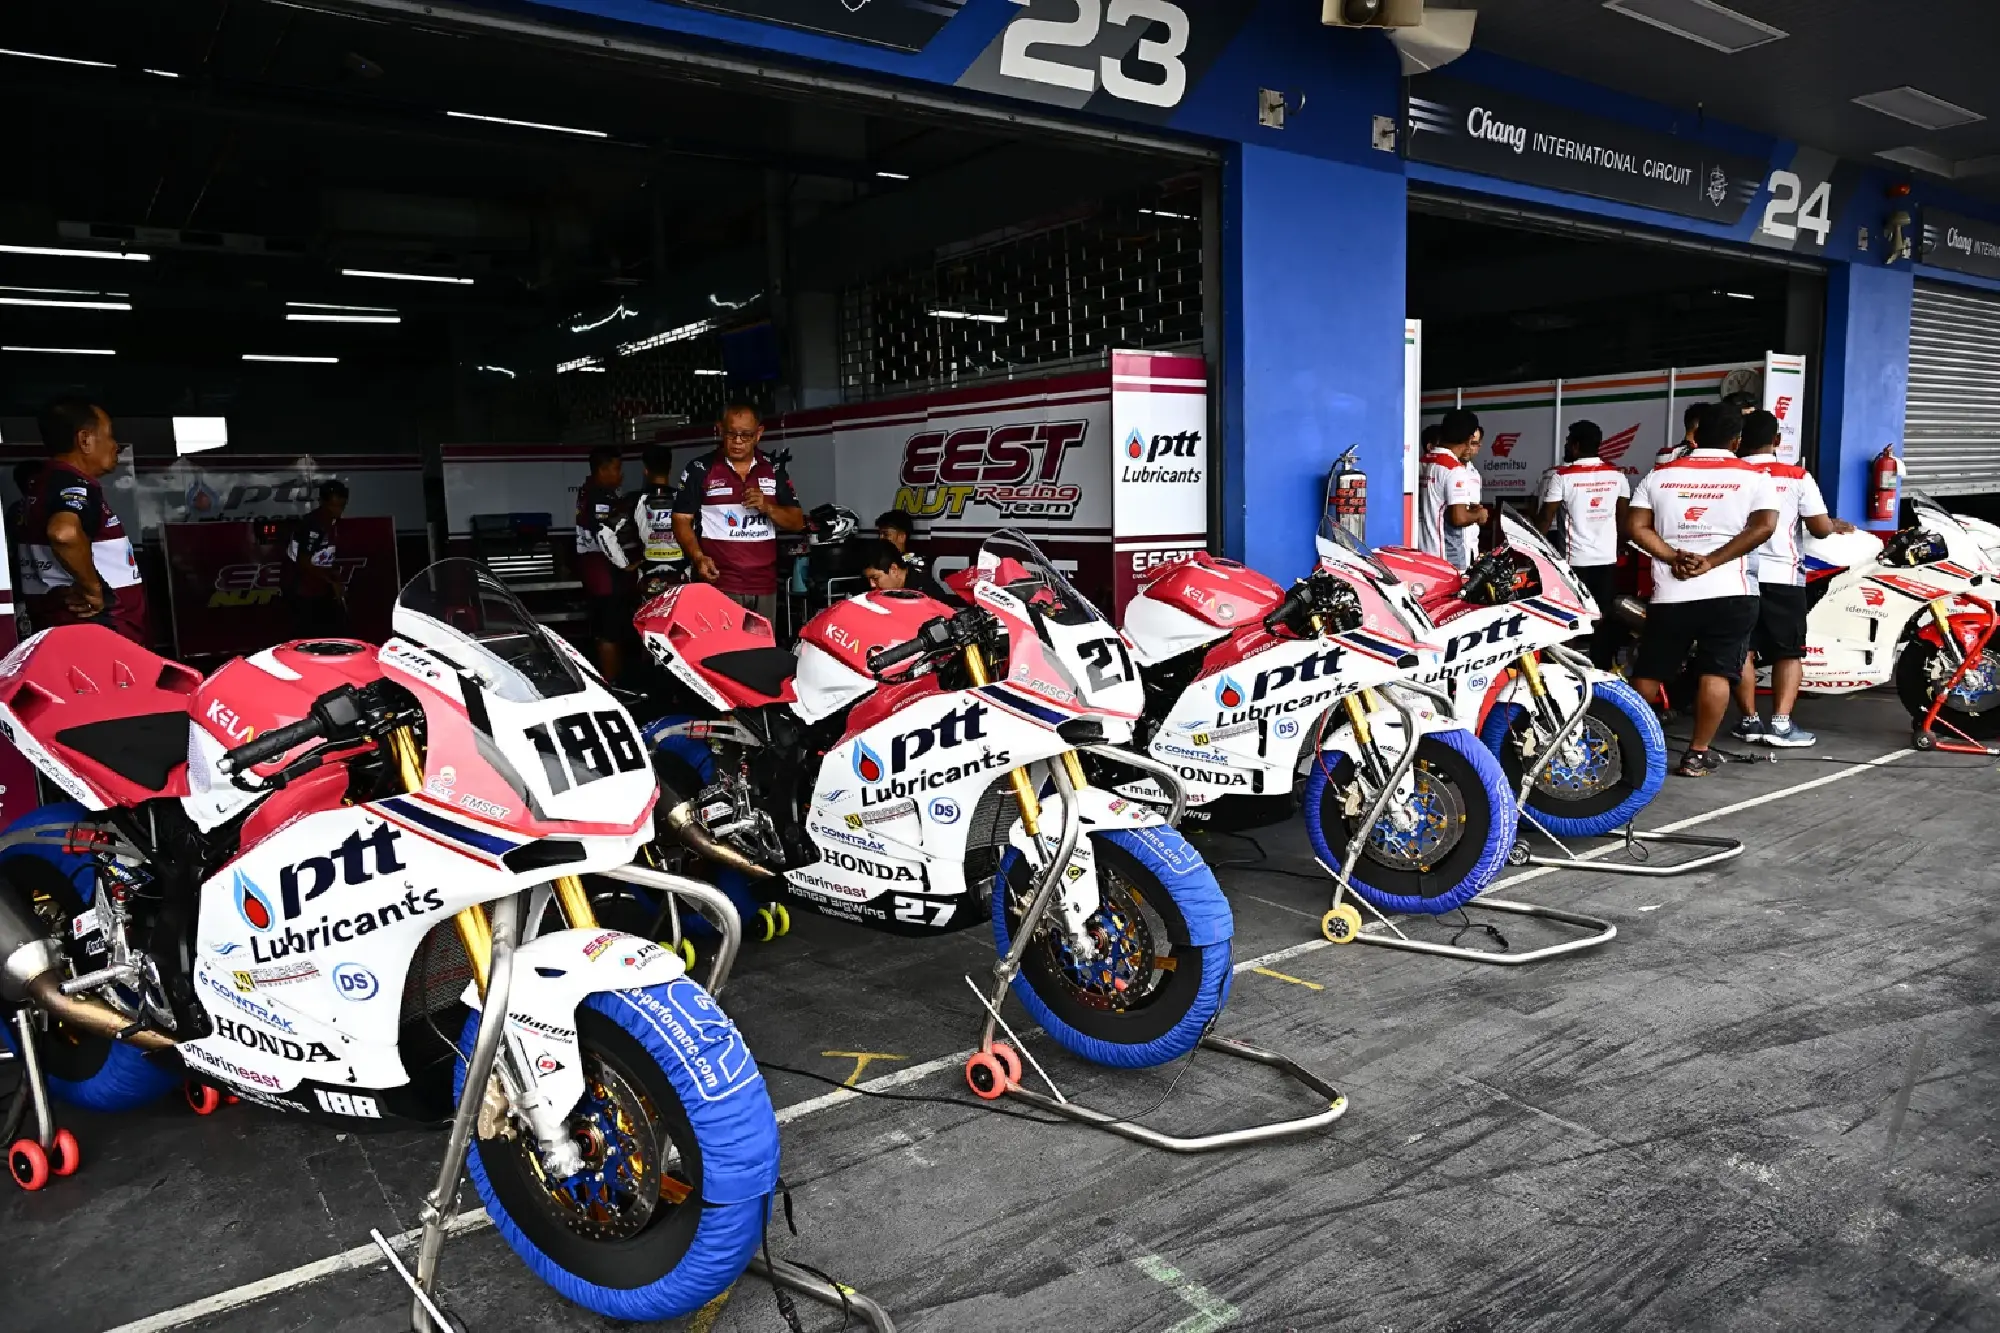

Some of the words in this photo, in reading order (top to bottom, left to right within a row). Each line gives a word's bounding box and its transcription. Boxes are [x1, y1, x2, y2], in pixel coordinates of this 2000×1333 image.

[1000, 0, 1190, 108] 23
[1466, 106, 1527, 154] Chang
[1532, 132, 1638, 174] INTERNATIONAL
[1642, 158, 1693, 186] CIRCUIT
[1762, 169, 1832, 246] 24
[1947, 227, 1973, 255] Chang
[900, 418, 1089, 487] EEST
[1147, 429, 1202, 463] ptt
[1121, 465, 1202, 484] Lubricants
[1483, 459, 1527, 471] idemitsu
[975, 483, 1082, 502] Racing
[1000, 500, 1076, 519] Team
[1444, 612, 1529, 664] ptt
[1251, 646, 1348, 703] ptt
[1216, 681, 1360, 729] Lubricants
[892, 699, 988, 775] ptt
[1279, 723, 1294, 734] DS
[522, 709, 647, 796] 188
[861, 750, 1011, 807] Lubricants
[460, 794, 511, 819] FMSCT
[935, 803, 954, 817] DS
[279, 820, 406, 921] ptt
[823, 847, 918, 881] HONDA
[795, 869, 868, 899] marineast
[249, 888, 445, 964] Lubricants
[894, 896, 958, 927] 27
[339, 973, 370, 992] DS
[214, 1014, 342, 1063] HONDA
[314, 1087, 383, 1119] 188
